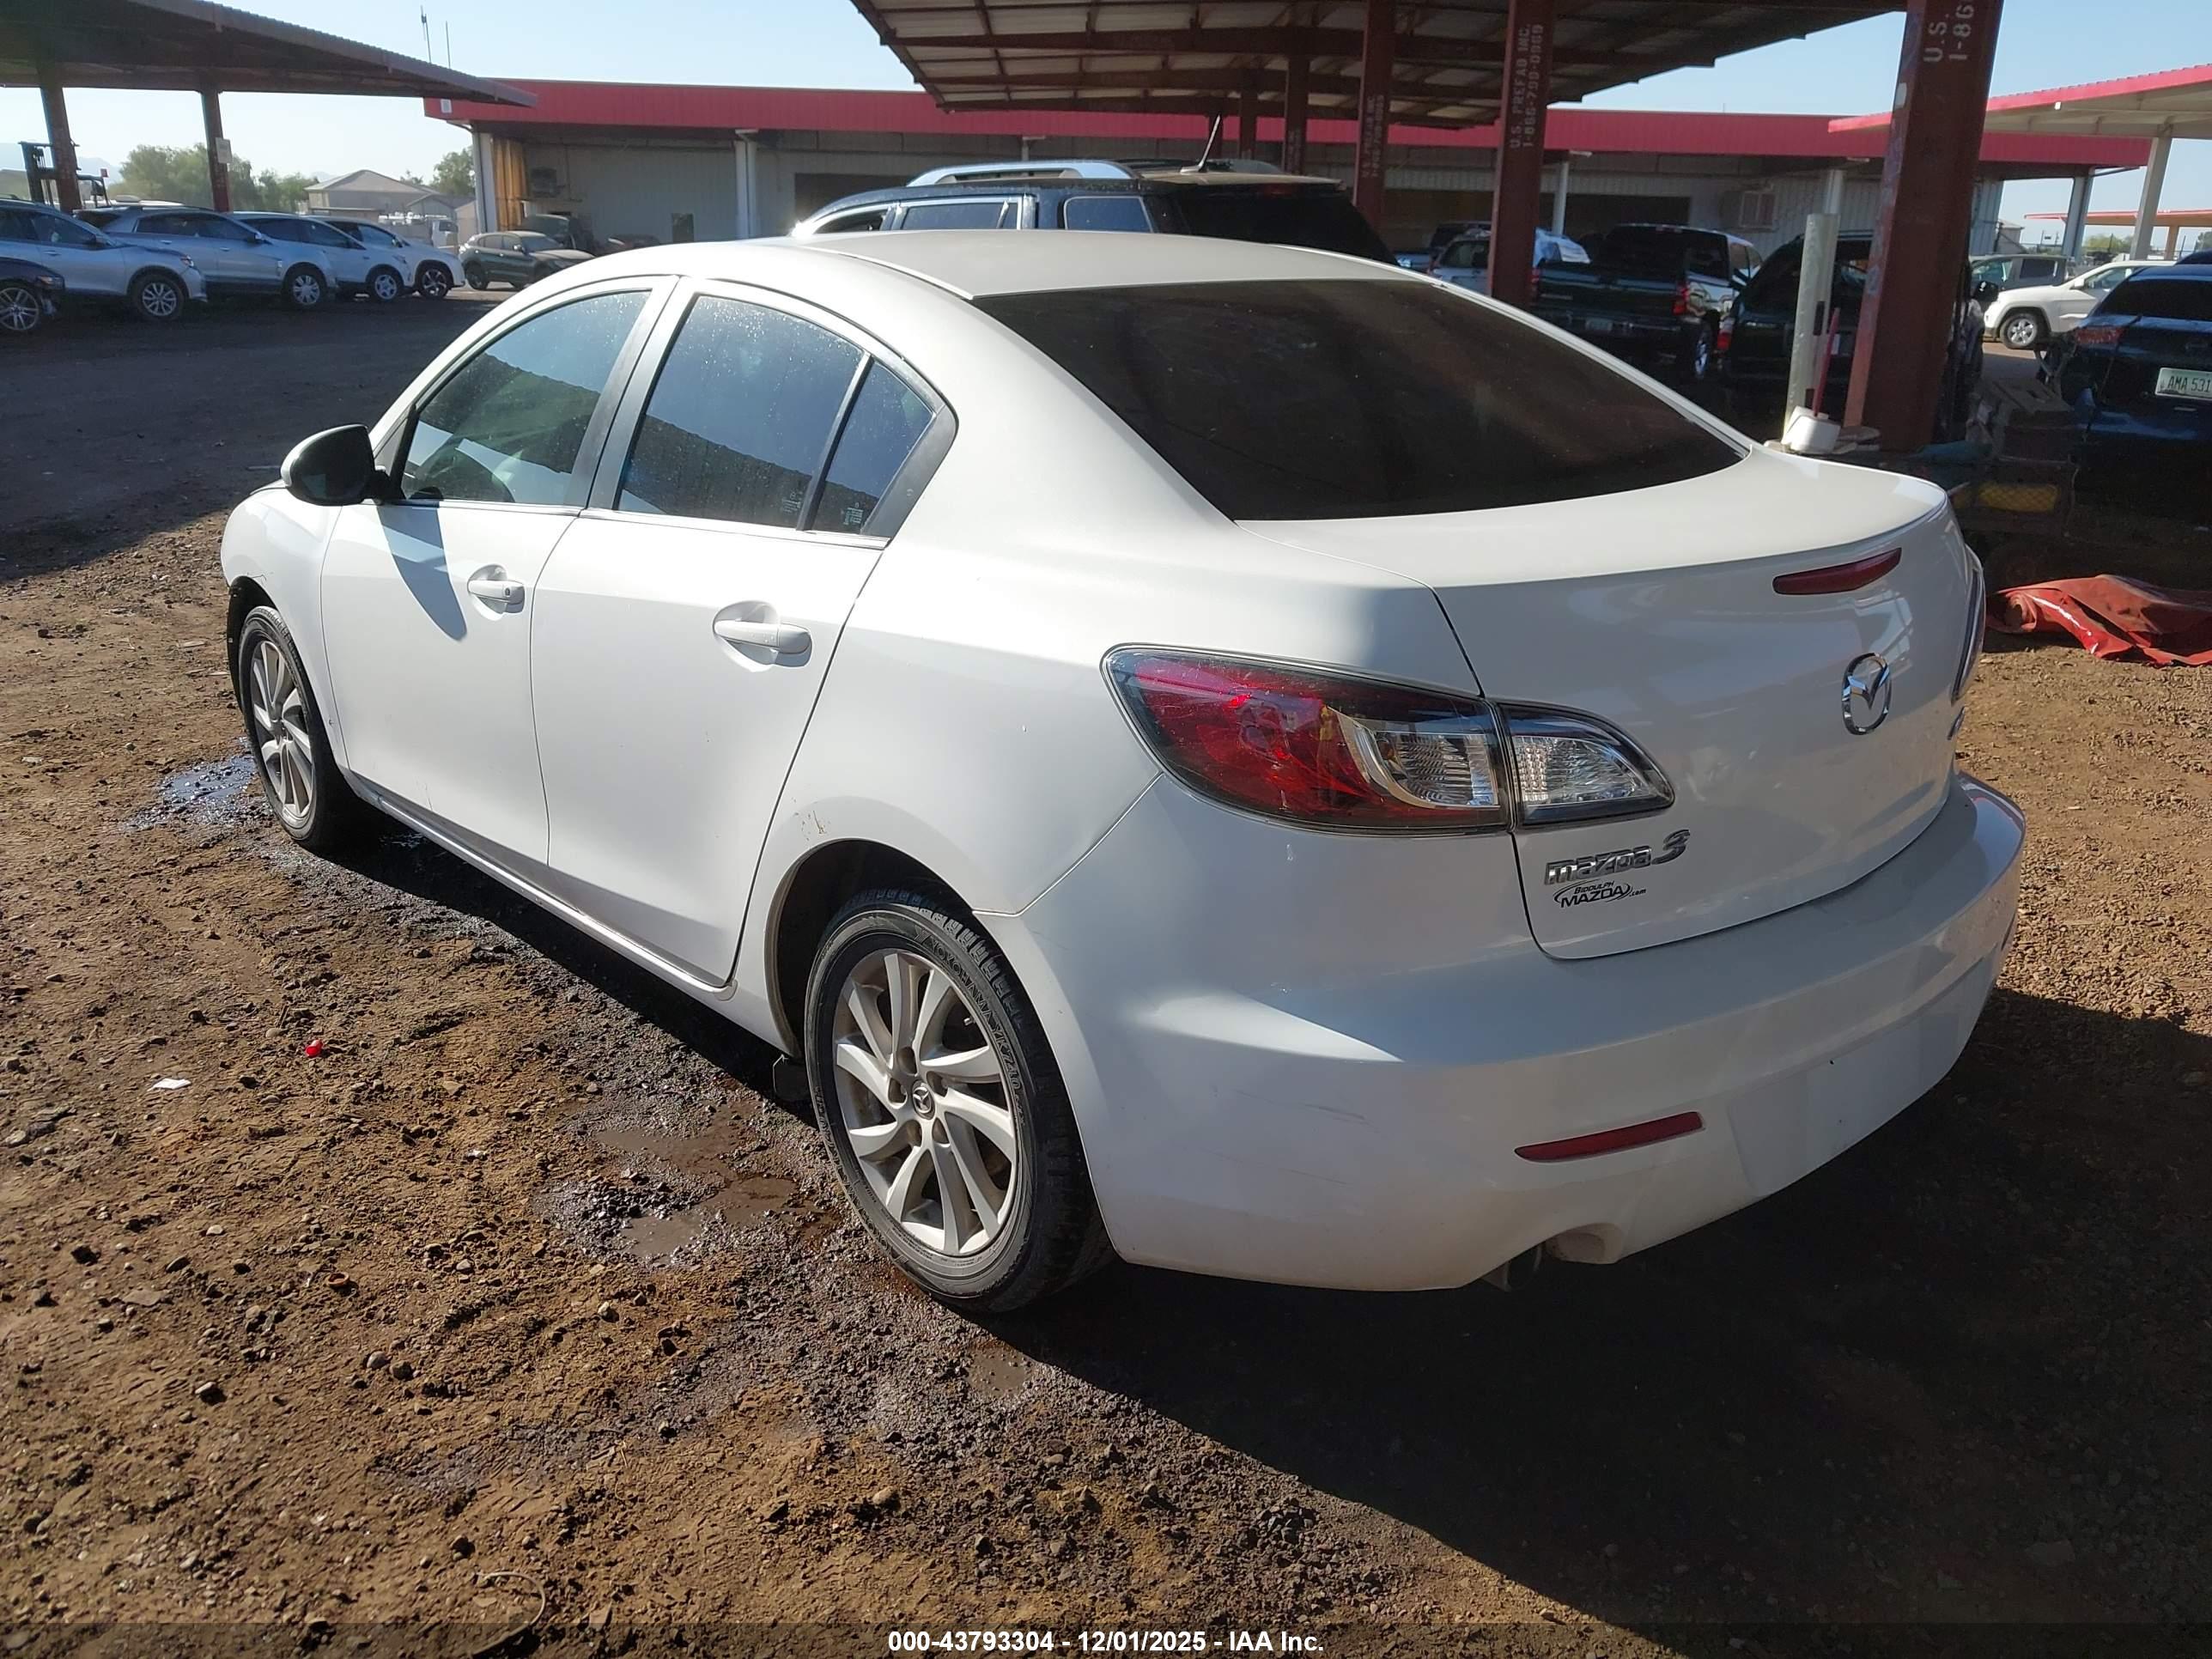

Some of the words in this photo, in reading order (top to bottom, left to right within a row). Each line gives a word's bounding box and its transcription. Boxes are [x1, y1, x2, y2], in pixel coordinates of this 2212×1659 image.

[1923, 13, 1949, 63] U.S.
[1560, 884, 1624, 908] MAZDA
[1573, 880, 1615, 895] BIDDULPH
[930, 936, 1001, 1030] YOKOHAMA
